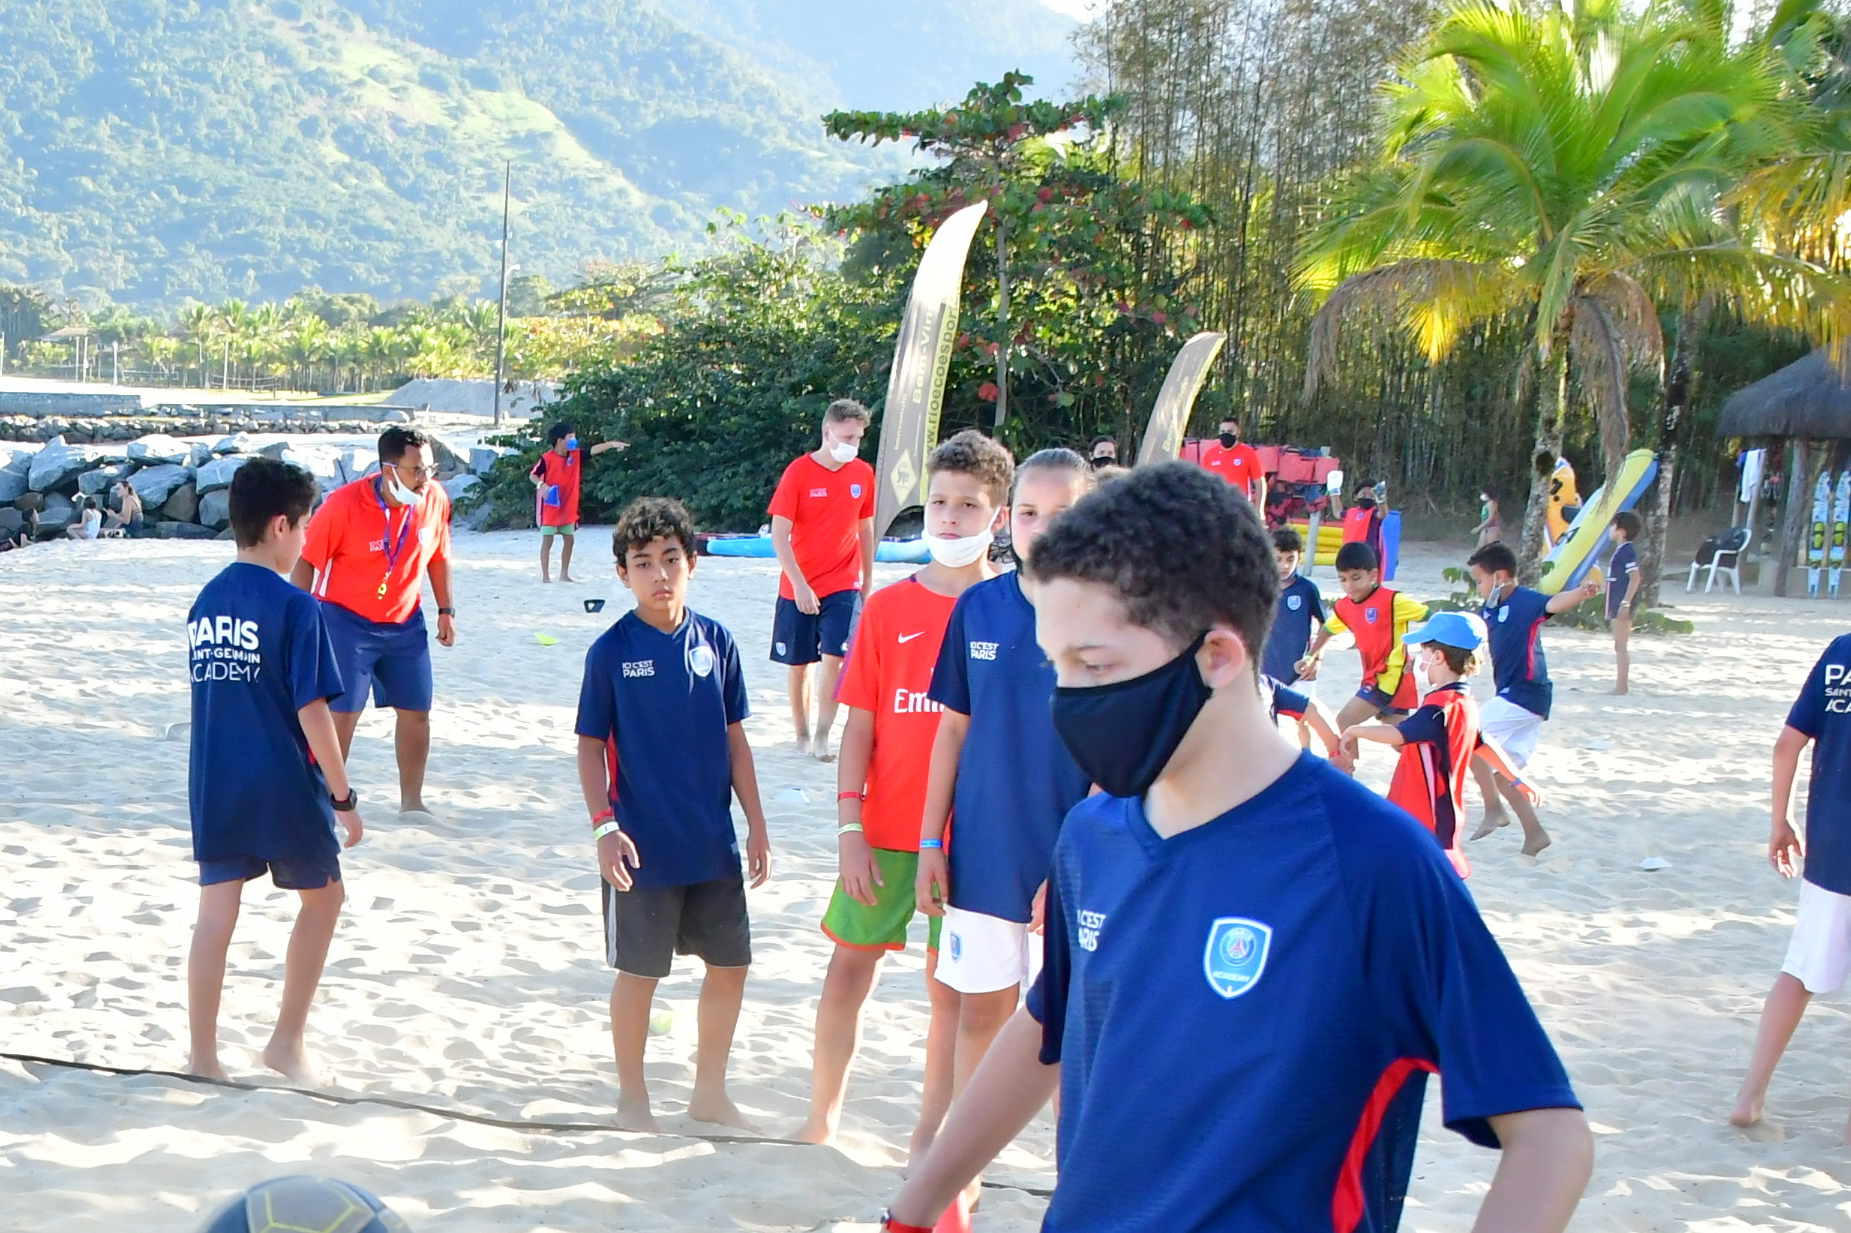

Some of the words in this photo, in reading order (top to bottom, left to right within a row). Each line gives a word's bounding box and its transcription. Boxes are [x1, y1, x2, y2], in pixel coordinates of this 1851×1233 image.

[188, 614, 259, 650] PARIS
[970, 649, 997, 660] PARIS
[623, 667, 655, 678] PARIS
